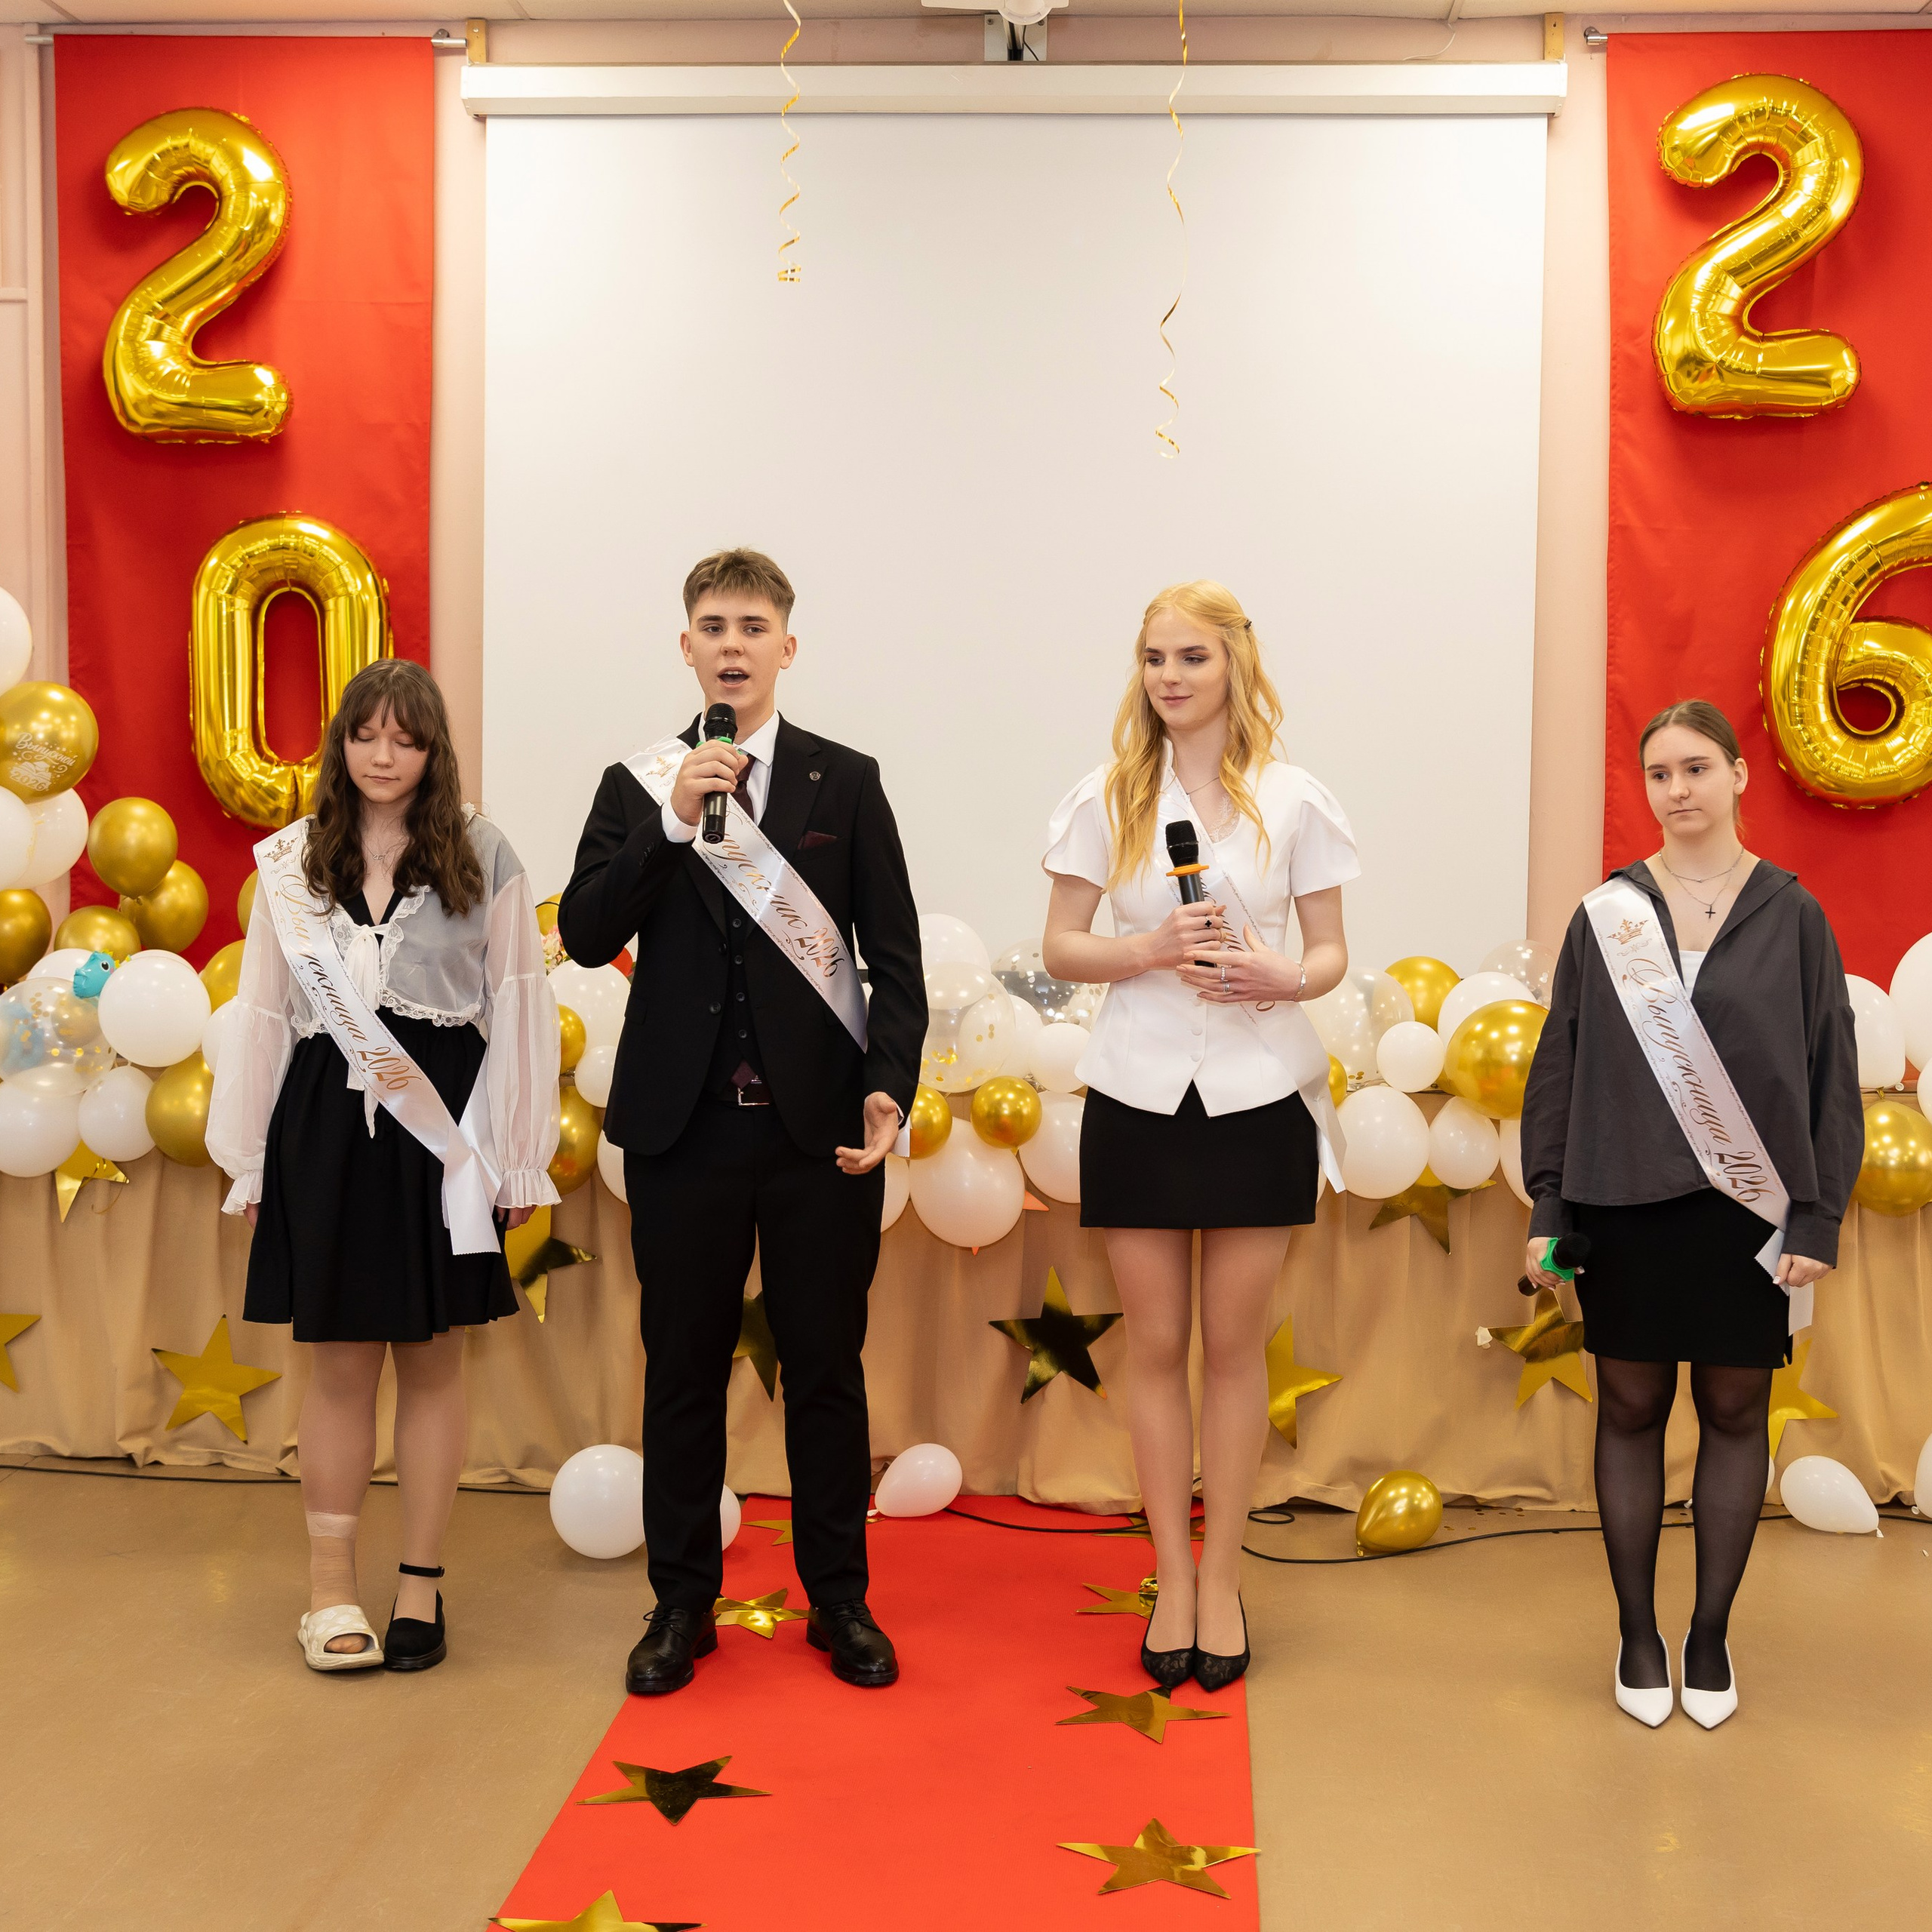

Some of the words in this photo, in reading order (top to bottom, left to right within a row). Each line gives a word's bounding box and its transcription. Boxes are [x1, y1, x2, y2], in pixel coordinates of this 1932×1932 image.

[103, 106, 294, 445] 2
[1651, 72, 1866, 420] 2
[16, 731, 78, 768] Выпускной
[188, 510, 395, 833] 0
[1758, 481, 1932, 810] 6
[10, 770, 48, 792] 2026
[356, 1046, 422, 1091] 2026
[795, 927, 845, 979] 2026
[1626, 958, 1733, 1146] Выпускница
[1713, 1150, 1777, 1204] 2026
